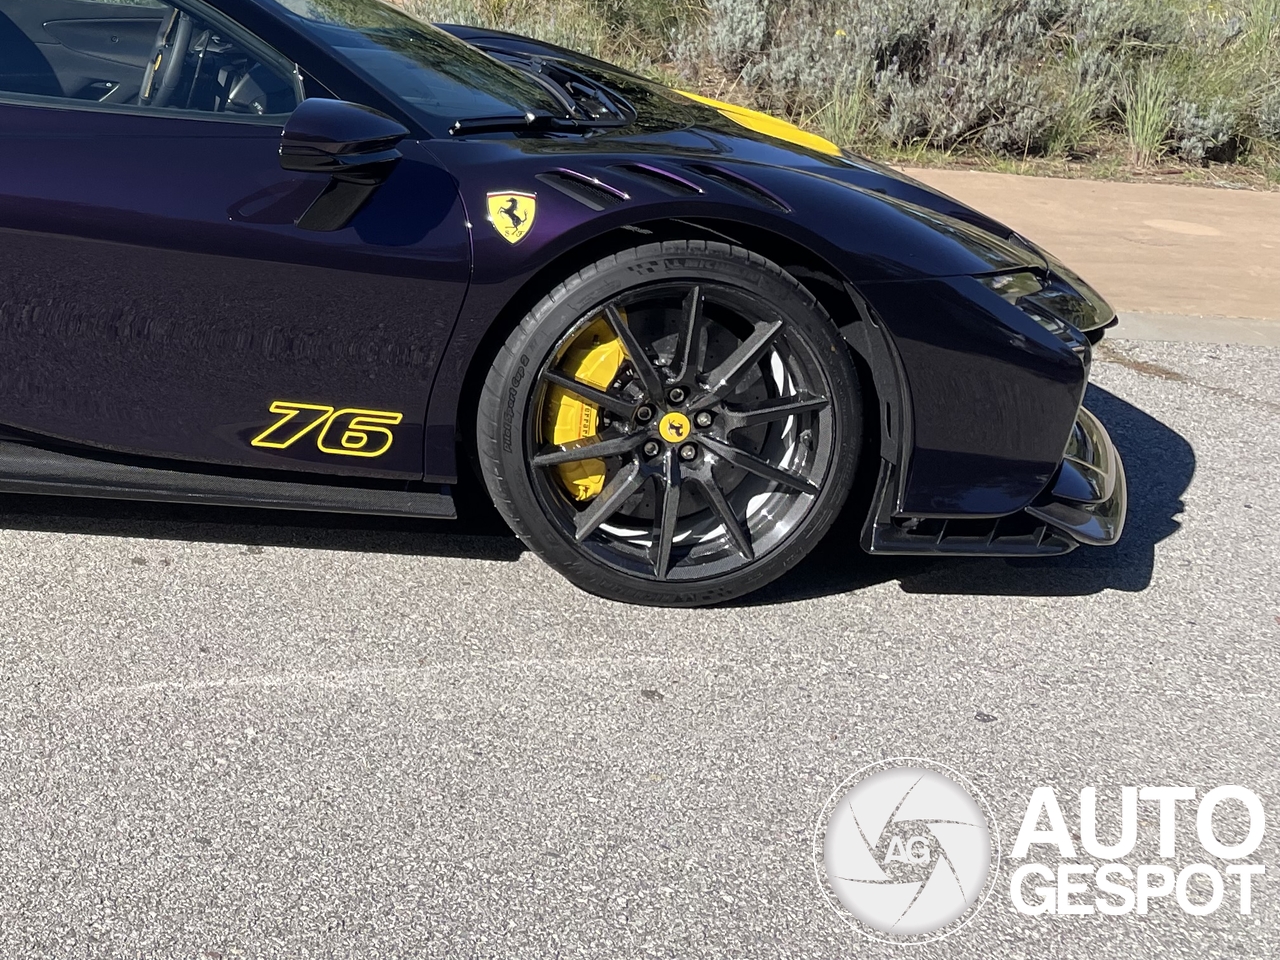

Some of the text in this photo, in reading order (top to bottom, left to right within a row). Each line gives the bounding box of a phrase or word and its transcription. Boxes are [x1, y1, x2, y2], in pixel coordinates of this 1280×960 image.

[251, 401, 403, 457] 76
[503, 354, 530, 454] Pilot Sport Cup 2
